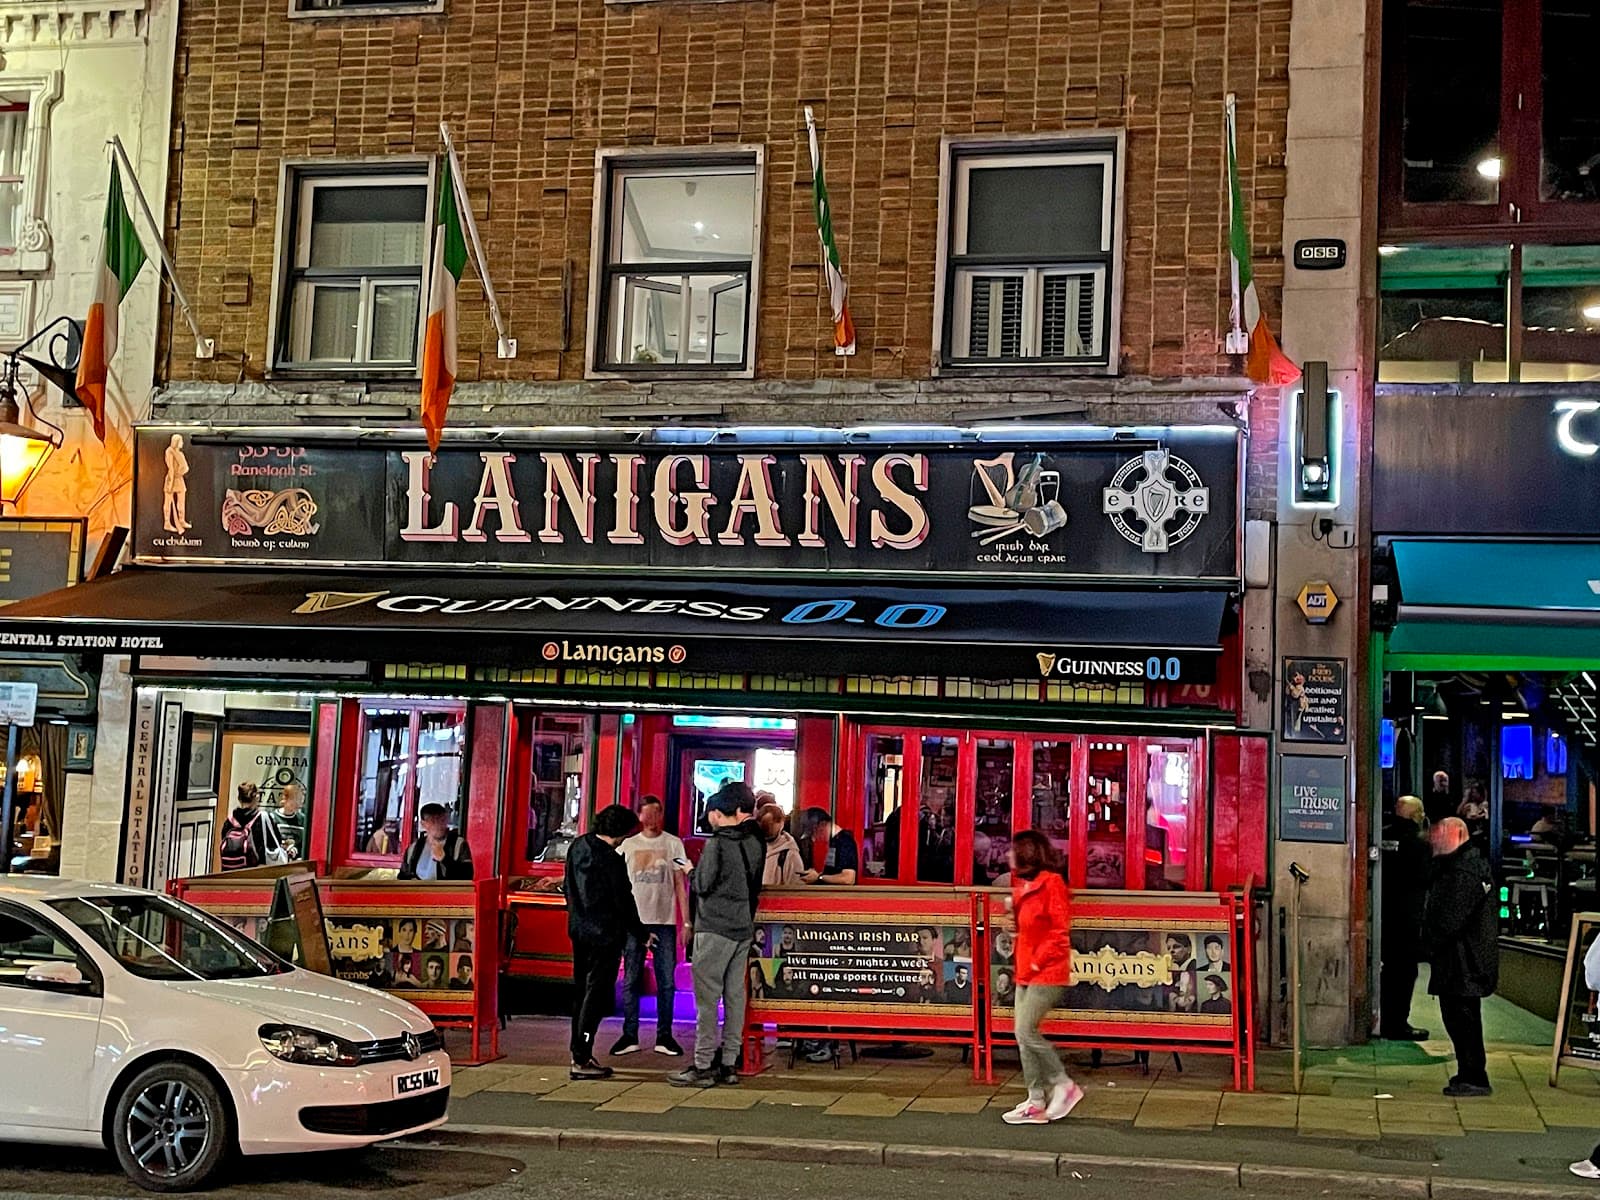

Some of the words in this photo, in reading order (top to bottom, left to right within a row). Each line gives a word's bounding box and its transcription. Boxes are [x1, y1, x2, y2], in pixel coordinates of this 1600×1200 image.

[1302, 247, 1338, 259] OSS
[231, 464, 296, 478] Ranelagh
[299, 464, 317, 476] St.
[400, 451, 930, 550] LANIGANS
[1307, 595, 1327, 606] ADT
[376, 594, 770, 621] GUINNESS
[781, 600, 947, 628] 0.0
[57, 635, 117, 648] STATION
[121, 636, 164, 649] HOTEL
[562, 640, 665, 665] Lanigans
[1057, 657, 1144, 676] GUINNESS
[1146, 656, 1181, 681] 0.0
[137, 719, 150, 800] CENTRAL
[255, 755, 308, 767] CENTRA
[1071, 962, 1155, 977] anigans
